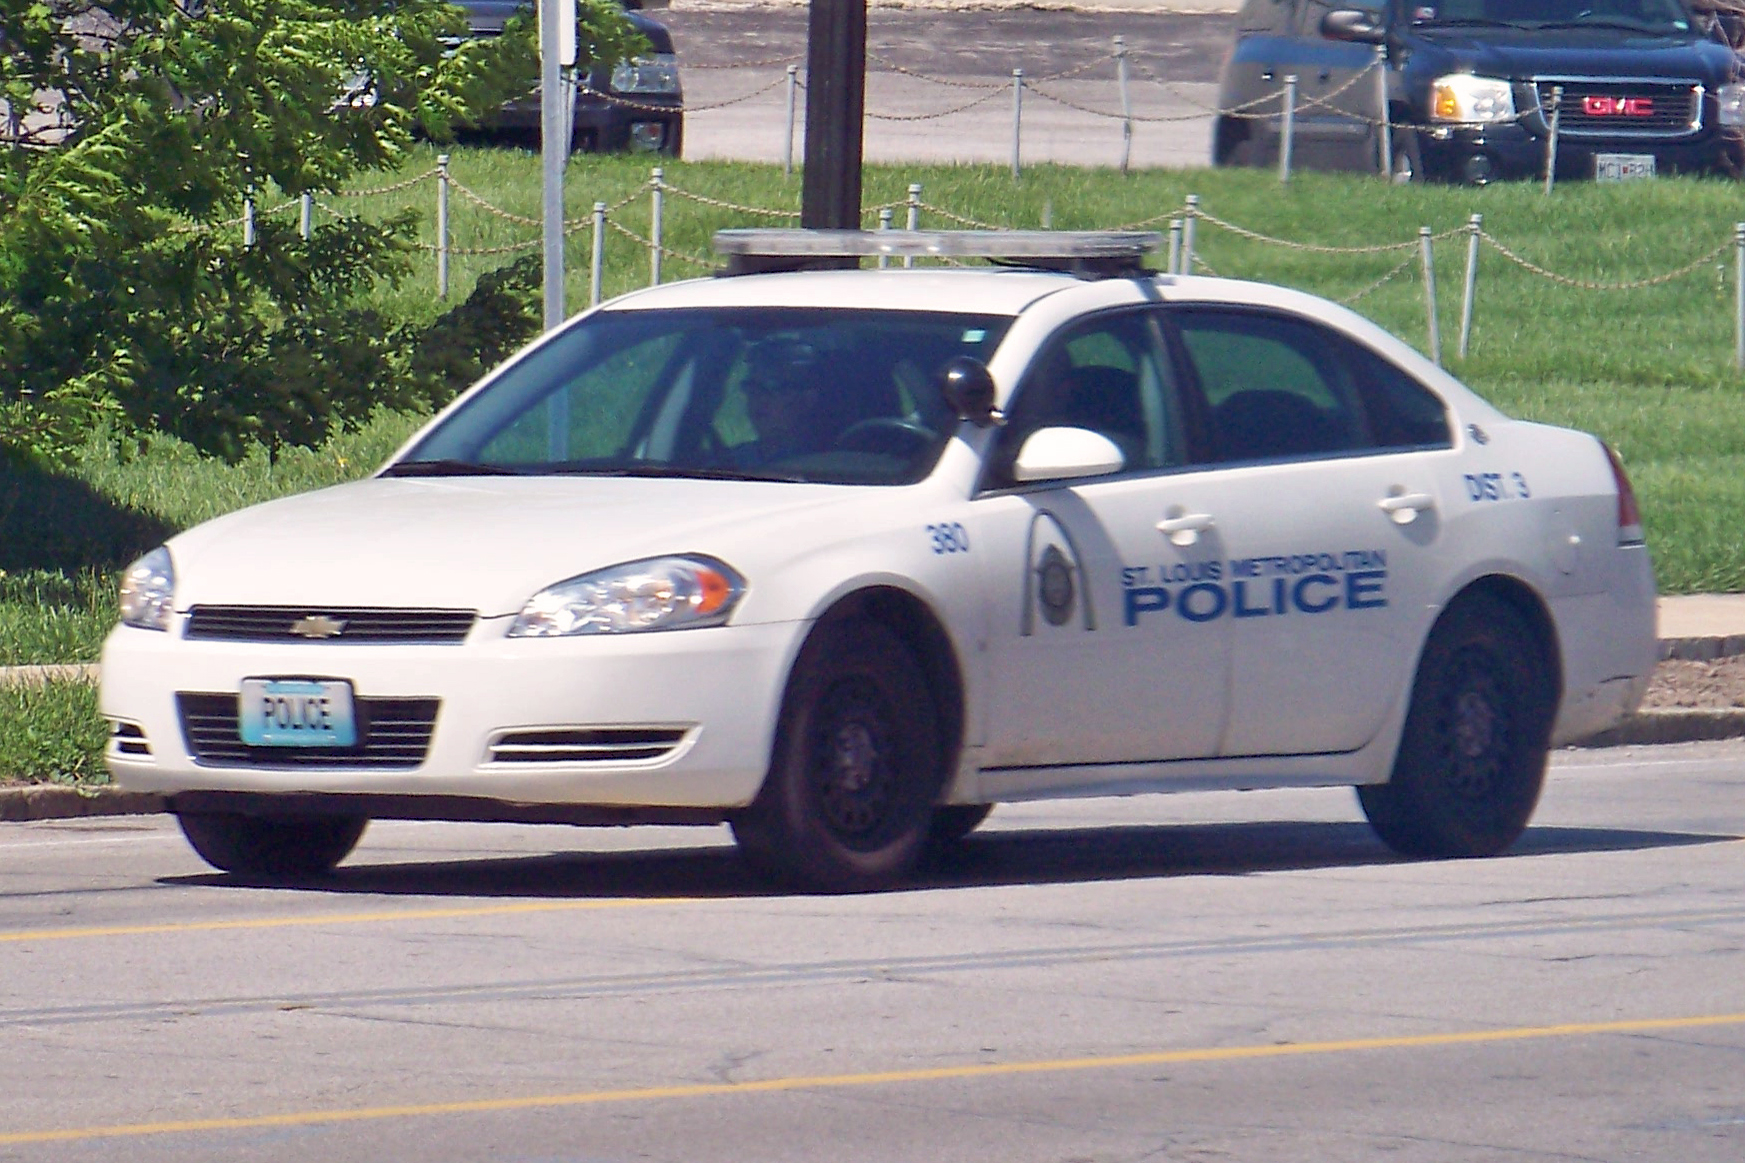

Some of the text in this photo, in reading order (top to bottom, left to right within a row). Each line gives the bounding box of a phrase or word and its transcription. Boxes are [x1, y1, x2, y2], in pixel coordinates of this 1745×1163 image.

[1583, 96, 1654, 117] GMC
[1511, 471, 1530, 499] 3
[926, 521, 969, 555] 380
[1160, 560, 1222, 584] LOUIS
[1229, 549, 1387, 579] METROPOLITAN
[1122, 570, 1389, 627] POLICE
[263, 697, 333, 731] POLICE
